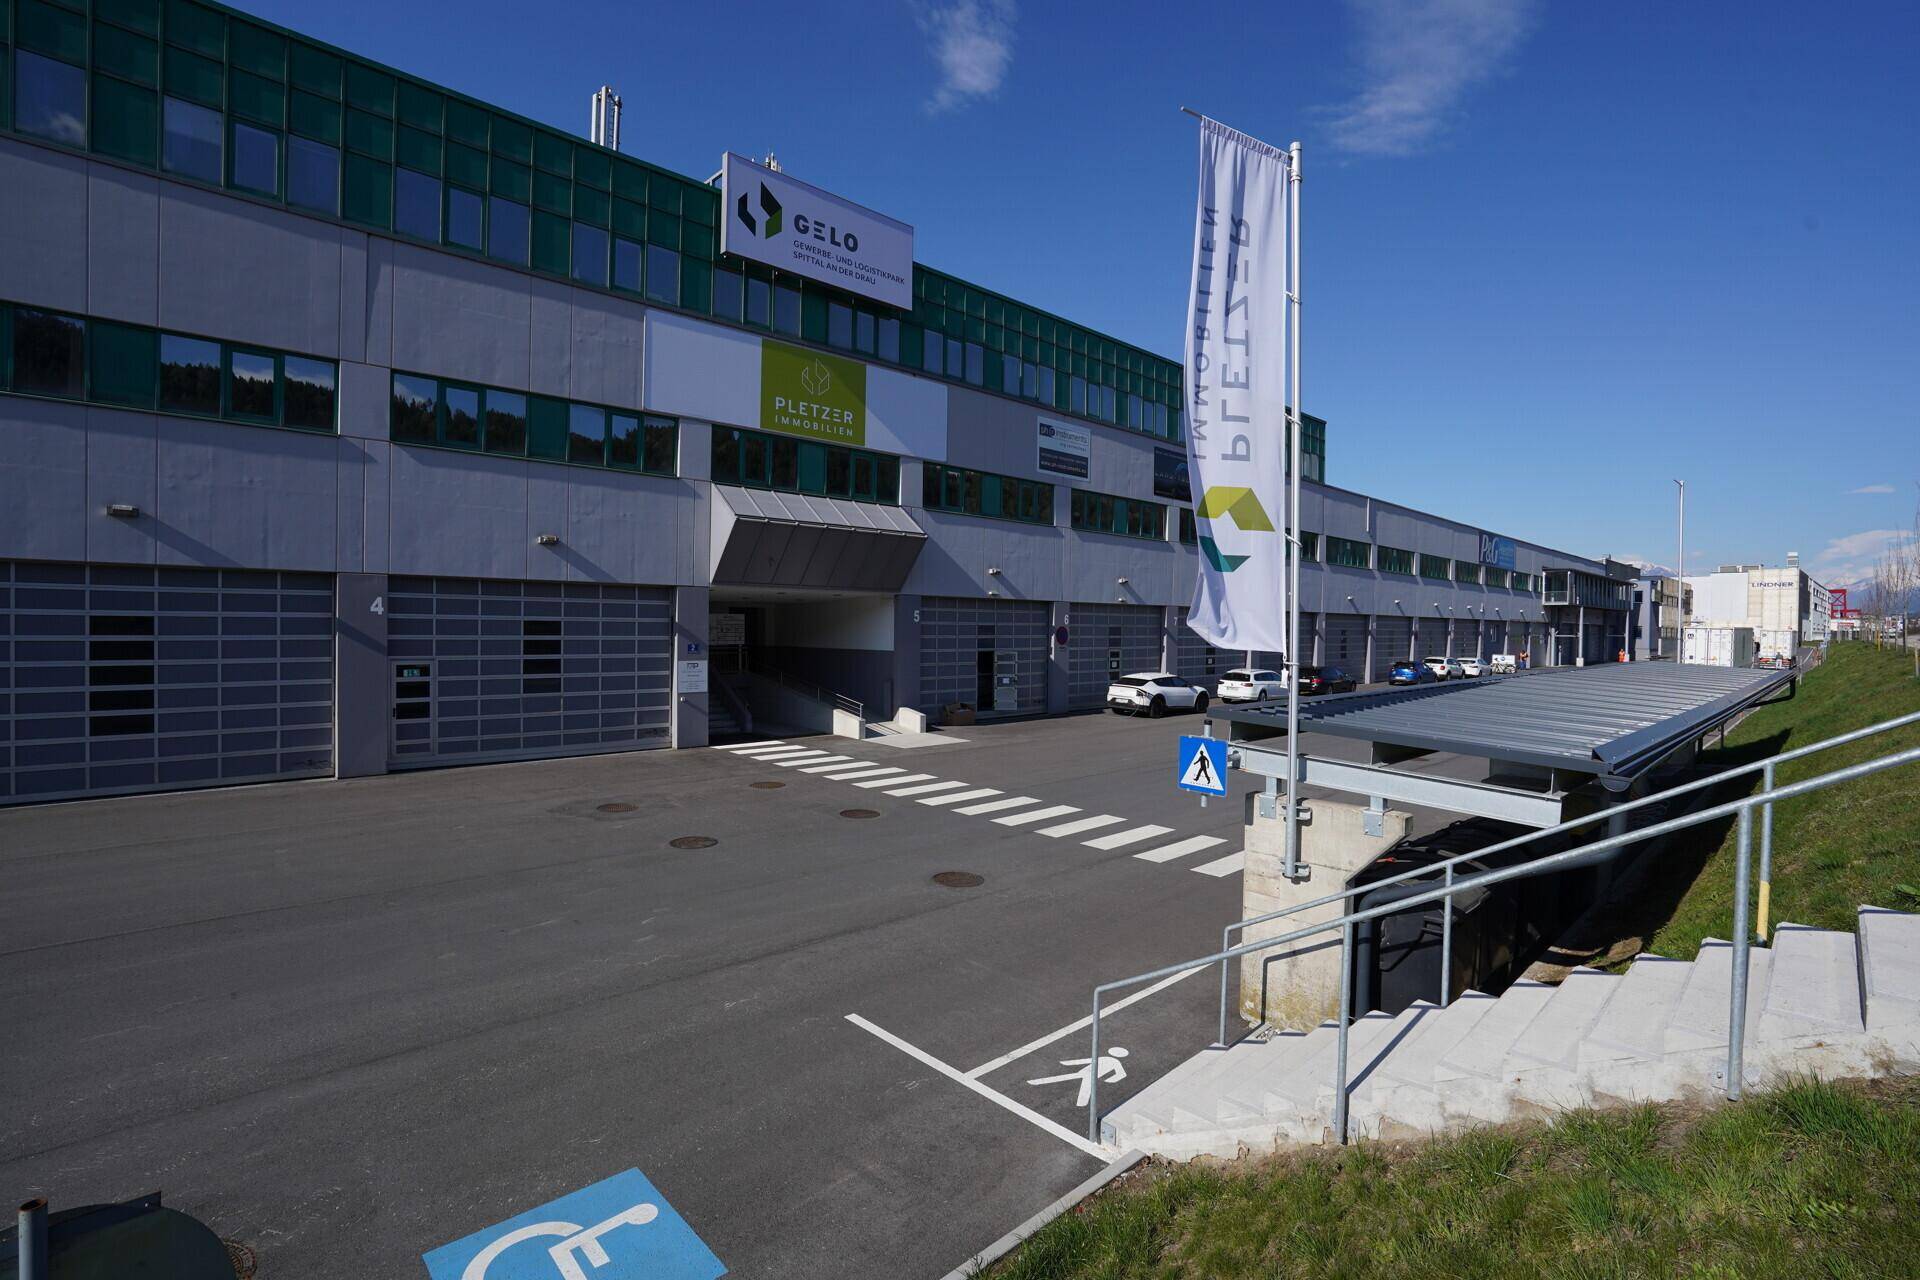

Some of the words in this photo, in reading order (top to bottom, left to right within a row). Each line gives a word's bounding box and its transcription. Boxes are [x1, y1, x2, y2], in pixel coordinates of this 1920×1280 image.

[793, 213, 859, 253] GELO
[793, 240, 835, 261] GEWERBE-
[835, 255, 853, 267] UND
[854, 260, 905, 286] LOGISTIKPARK
[793, 250, 825, 269] SPITTAL
[826, 262, 838, 273] AN
[839, 266, 854, 279] DER
[855, 272, 876, 286] DRAU
[775, 396, 854, 425] PLETZER
[775, 415, 852, 436] IMMOBILIEN
[1480, 533, 1500, 565] P&G
[1751, 580, 1794, 588] LINDNER
[369, 596, 384, 616] 4
[913, 610, 920, 623] 5
[1064, 614, 1069, 626] 6
